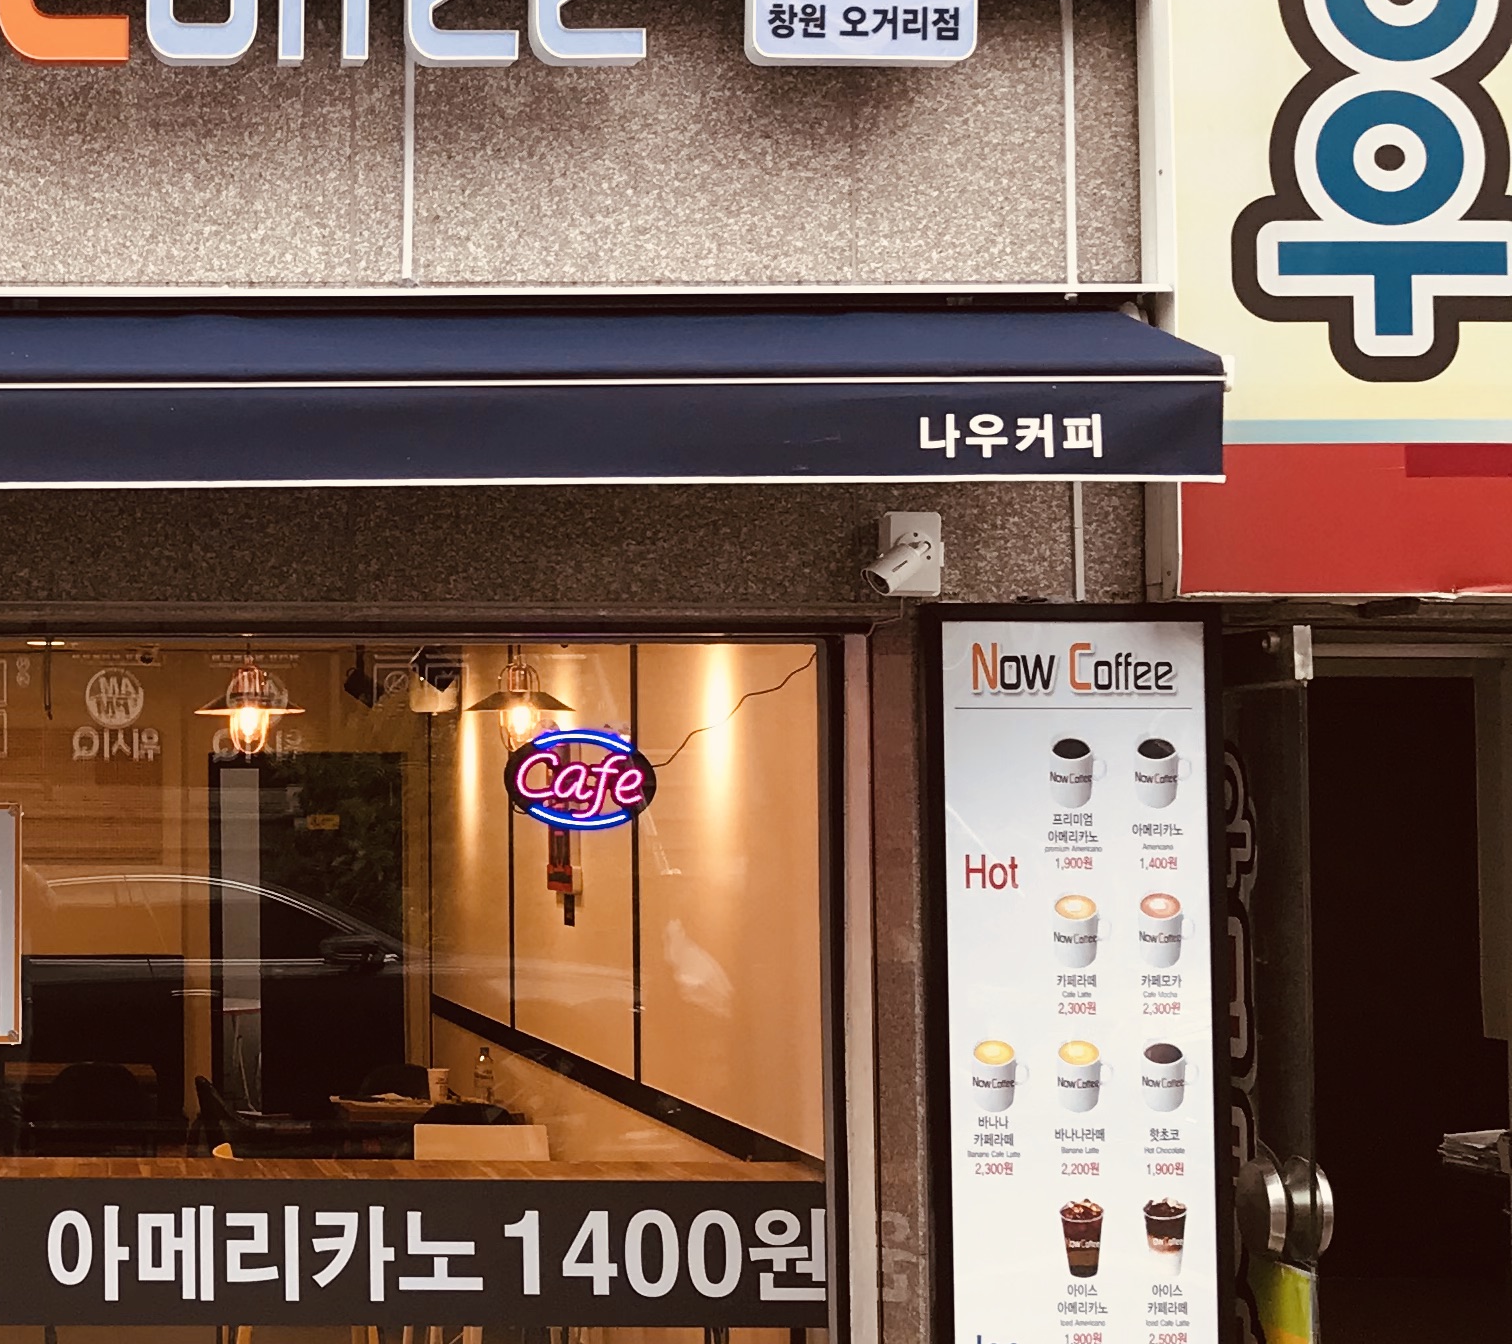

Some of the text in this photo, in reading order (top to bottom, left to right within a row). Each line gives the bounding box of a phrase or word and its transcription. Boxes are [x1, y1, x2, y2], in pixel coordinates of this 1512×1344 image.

[766, 2, 961, 44] 창원 오거리점
[919, 412, 1104, 459] 나우커피
[1068, 642, 1175, 691] Coffee
[515, 751, 645, 819] Cafe
[1052, 813, 1093, 826] 프리미엄
[1047, 830, 1099, 843] 아메리카노
[1131, 823, 1184, 836] 아메리카노
[1055, 857, 1093, 870] 1,900원
[1139, 857, 1177, 870] 1,400원
[964, 854, 1019, 890] Hot
[1056, 974, 1097, 988] 카페라떼
[1141, 974, 1182, 988] 카페모카
[1058, 1002, 1097, 1015] 2,300원
[1143, 1002, 1181, 1015] 2,300원
[978, 1116, 1009, 1130] 바나나
[973, 1133, 1014, 1147] 카페라떼
[1055, 1128, 1105, 1142] 바나나라떼
[1149, 1128, 1180, 1141] 핫초코
[975, 1162, 1014, 1176] 2,300원
[1061, 1162, 1100, 1176] 2,200원
[1147, 1162, 1185, 1176] 1,900원
[46, 1204, 485, 1303] 아메리카노
[503, 1207, 827, 1302] 1400원
[1067, 1284, 1098, 1297] 아이스
[1151, 1284, 1183, 1297] 아이스
[1057, 1301, 1108, 1315] 아메리카노
[1147, 1301, 1188, 1315] 카페라떼
